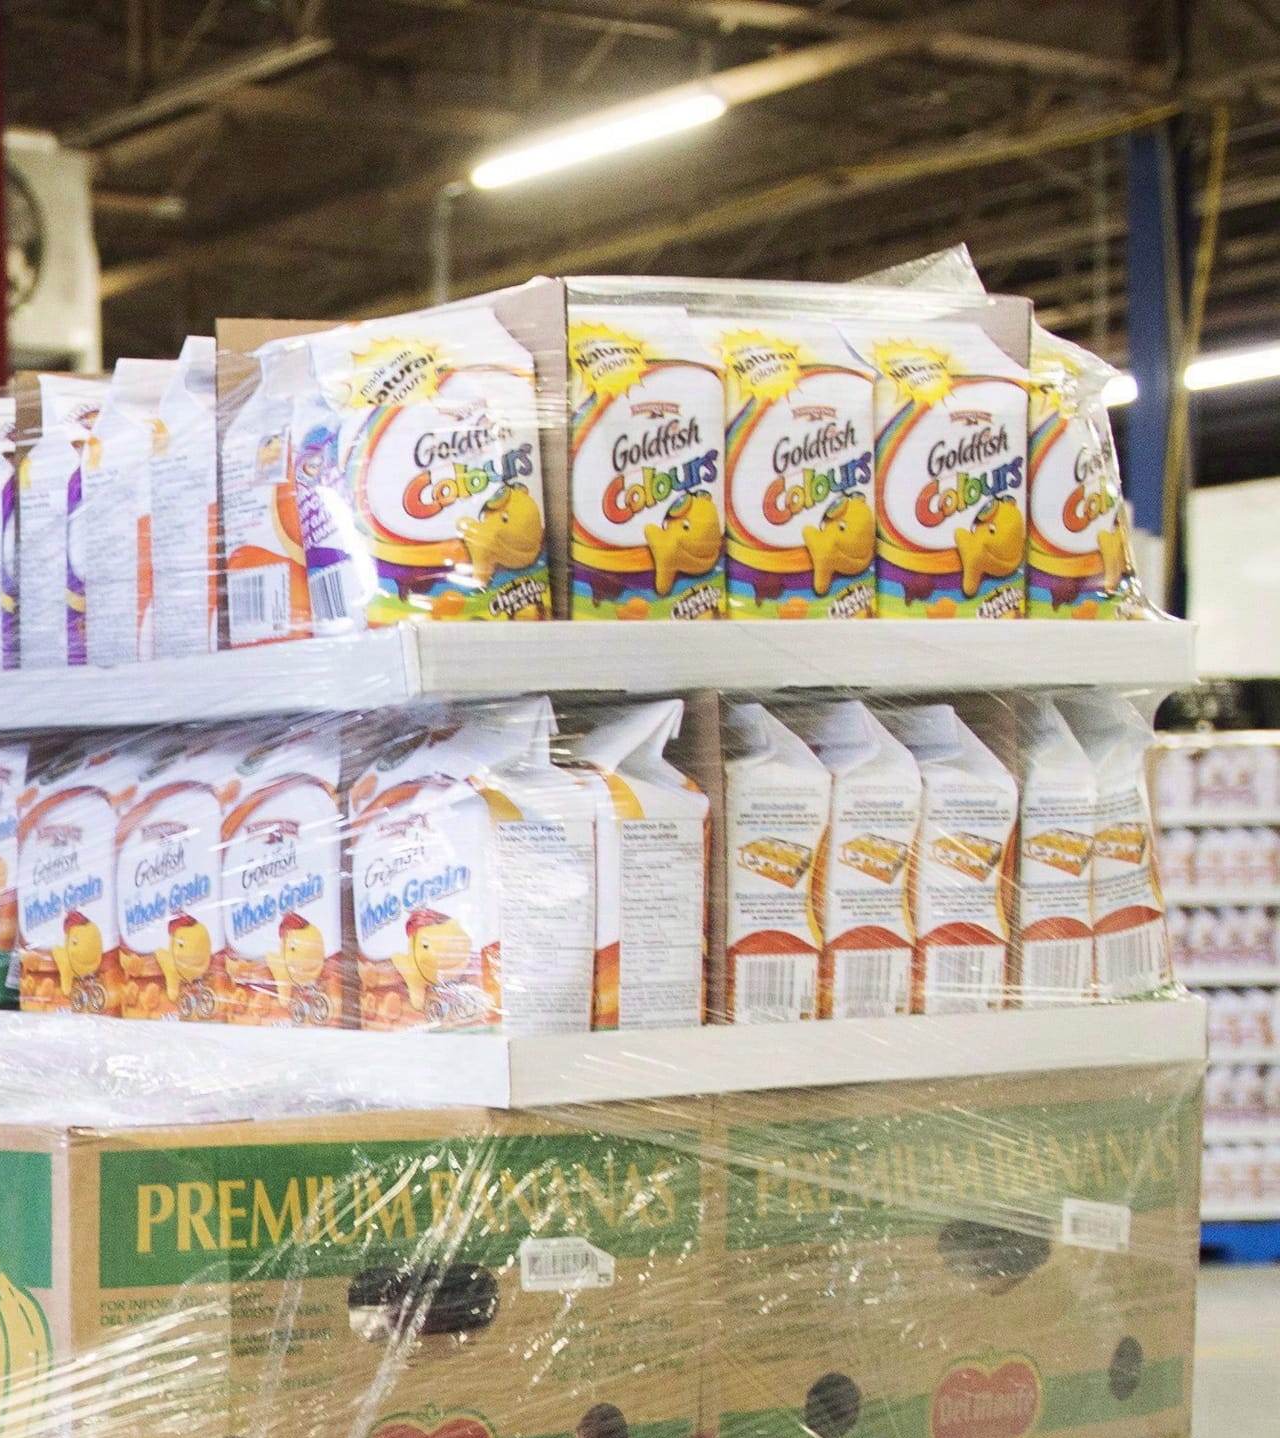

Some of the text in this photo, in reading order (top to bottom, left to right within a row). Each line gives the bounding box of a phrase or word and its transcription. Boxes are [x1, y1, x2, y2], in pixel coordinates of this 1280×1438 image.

[368, 352, 435, 405] atural
[576, 346, 641, 368] Natural
[732, 350, 796, 376] Natural
[612, 416, 701, 472] Goldfish
[772, 420, 856, 475] Goldfish
[927, 427, 1008, 477] Goldfish
[403, 443, 534, 520] Colours
[602, 449, 719, 524] Colours
[762, 451, 872, 526] Colours
[915, 456, 1023, 527] Colours
[134, 845, 185, 887] Goldfish
[403, 865, 470, 912] Grain
[24, 875, 102, 928] Whole Grain
[124, 873, 210, 933] Whole Grain
[232, 872, 323, 936] Whole Grain
[136, 1160, 677, 1254] PREMIUM BANANAS
